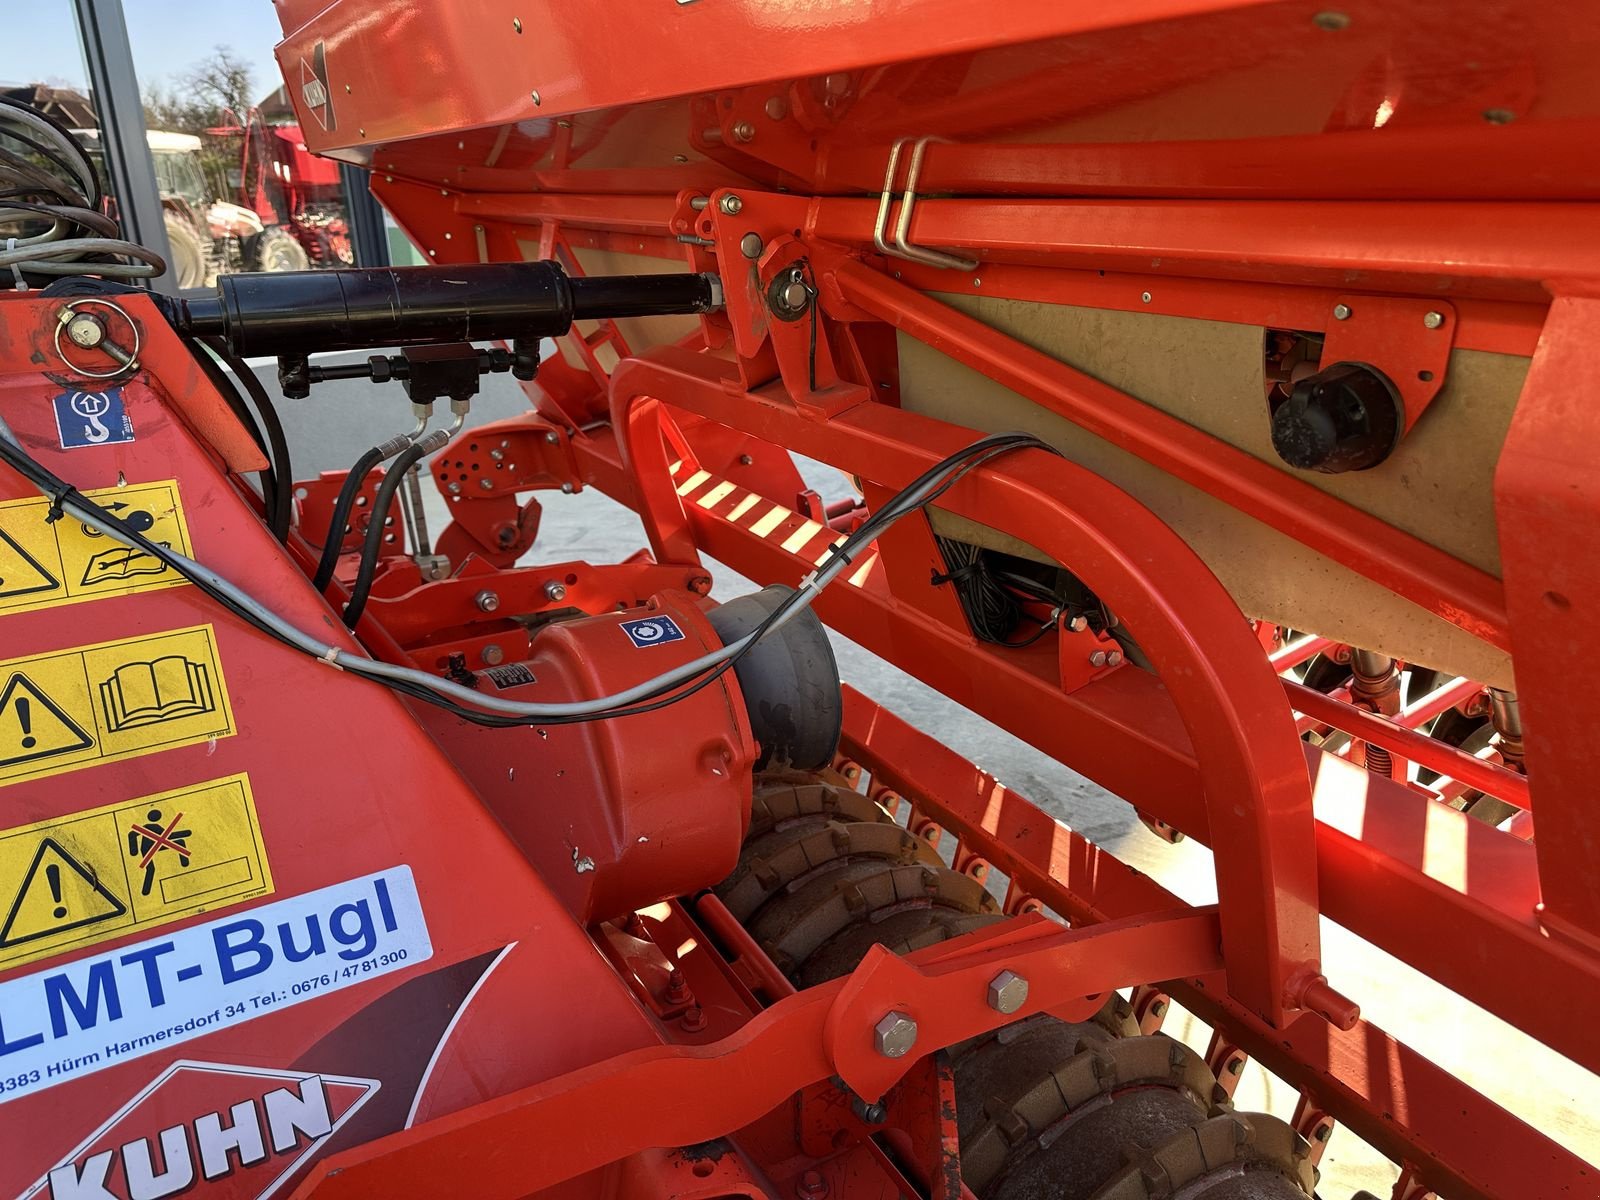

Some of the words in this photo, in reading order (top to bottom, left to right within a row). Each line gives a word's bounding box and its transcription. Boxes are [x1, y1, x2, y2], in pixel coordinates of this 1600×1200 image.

[0, 878, 399, 1057] LMT-Bugl
[47, 1052, 100, 1078] Hürm
[105, 1009, 220, 1058] Harmersdorf
[225, 1002, 246, 1018] 34
[250, 990, 287, 1009] Tel.:
[291, 973, 331, 996] 0676
[48, 1074, 333, 1200] KUHN
